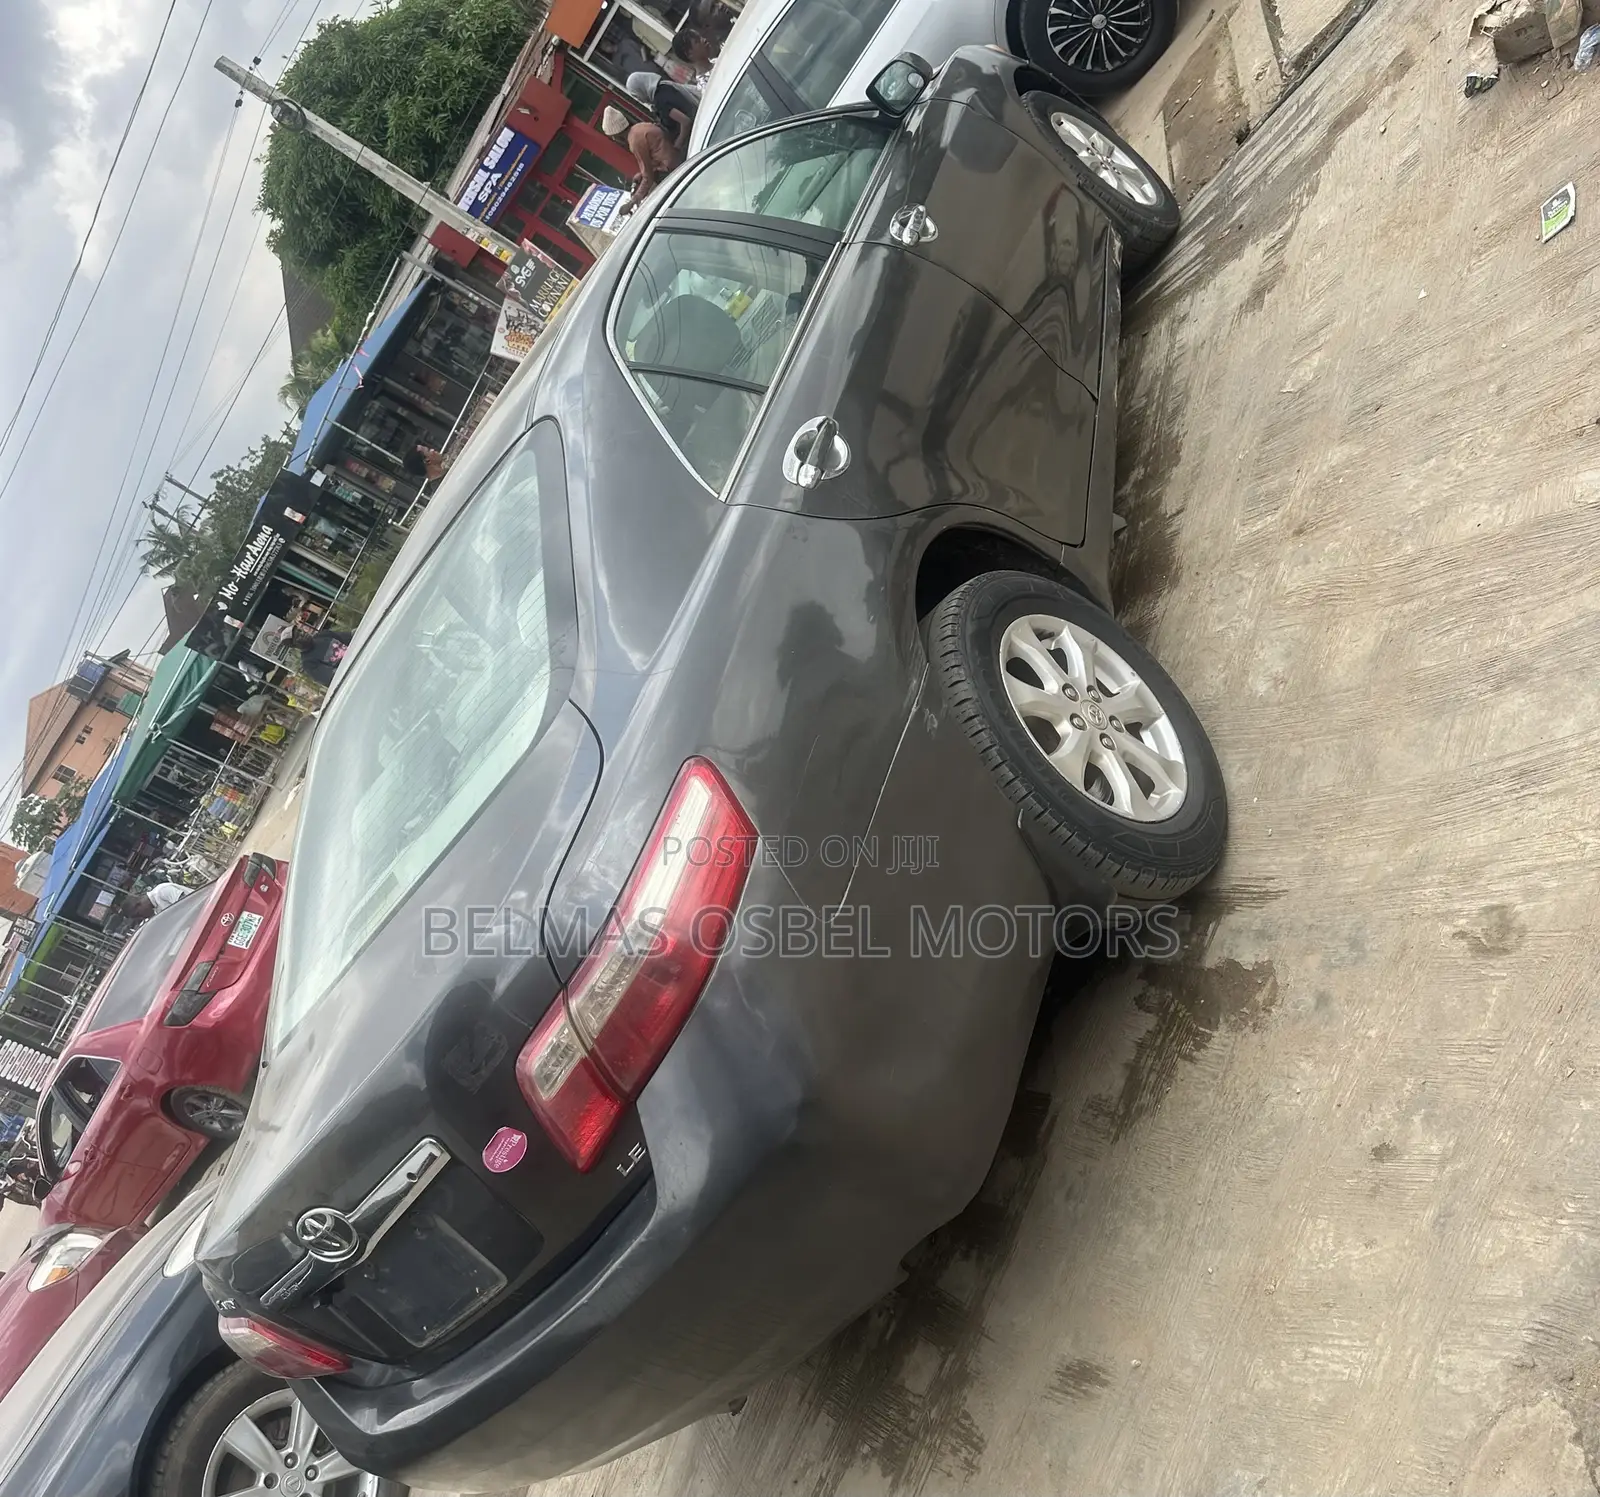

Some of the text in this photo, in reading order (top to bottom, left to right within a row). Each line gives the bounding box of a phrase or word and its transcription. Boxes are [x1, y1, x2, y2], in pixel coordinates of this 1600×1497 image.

[458, 168, 491, 211] VERSAL
[483, 127, 515, 170] SALON
[477, 172, 502, 203] SPA
[590, 217, 604, 228] US
[594, 206, 611, 221] FOR
[529, 269, 560, 312] MARRIAGE
[493, 1137, 517, 1168] Prestige
[616, 1141, 646, 1177] LE
